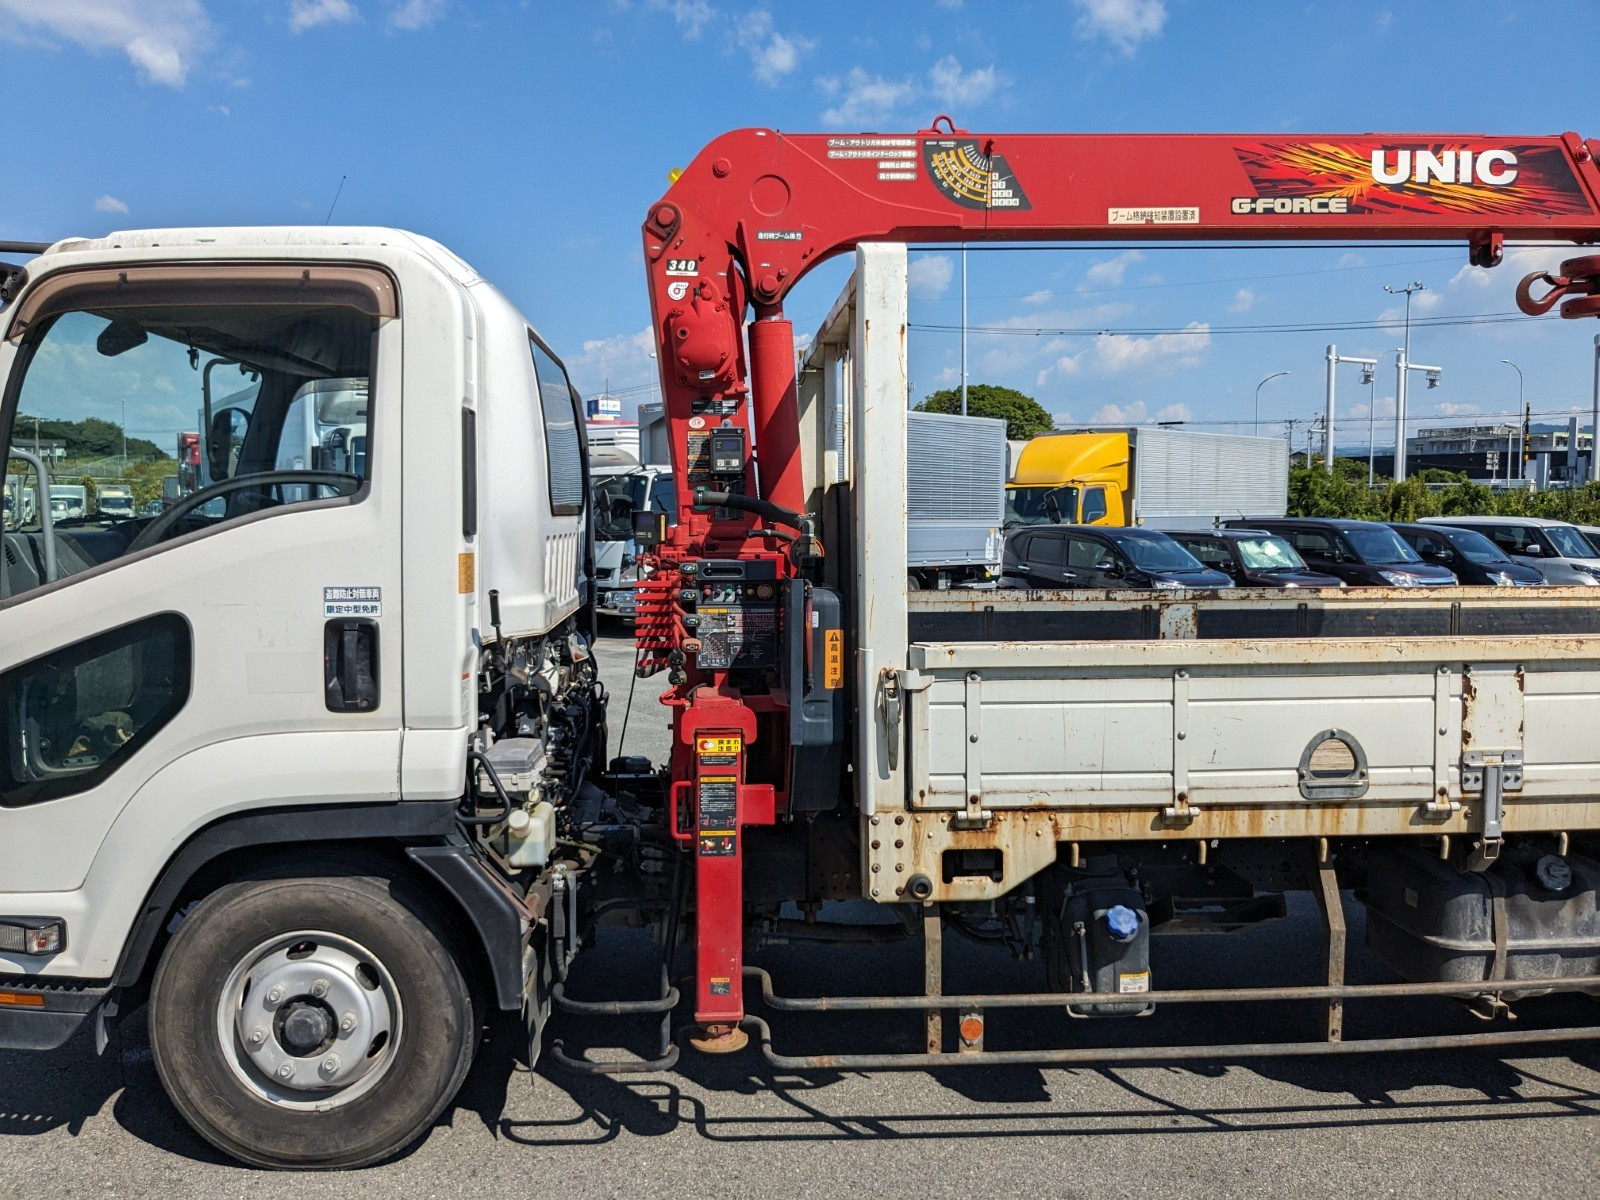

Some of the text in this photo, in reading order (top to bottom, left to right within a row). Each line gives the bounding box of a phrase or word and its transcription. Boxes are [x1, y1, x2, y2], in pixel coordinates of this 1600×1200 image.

[1371, 150, 1518, 186] UNIC
[668, 259, 696, 271] 340
[327, 605, 379, 613] 限定中型免許
